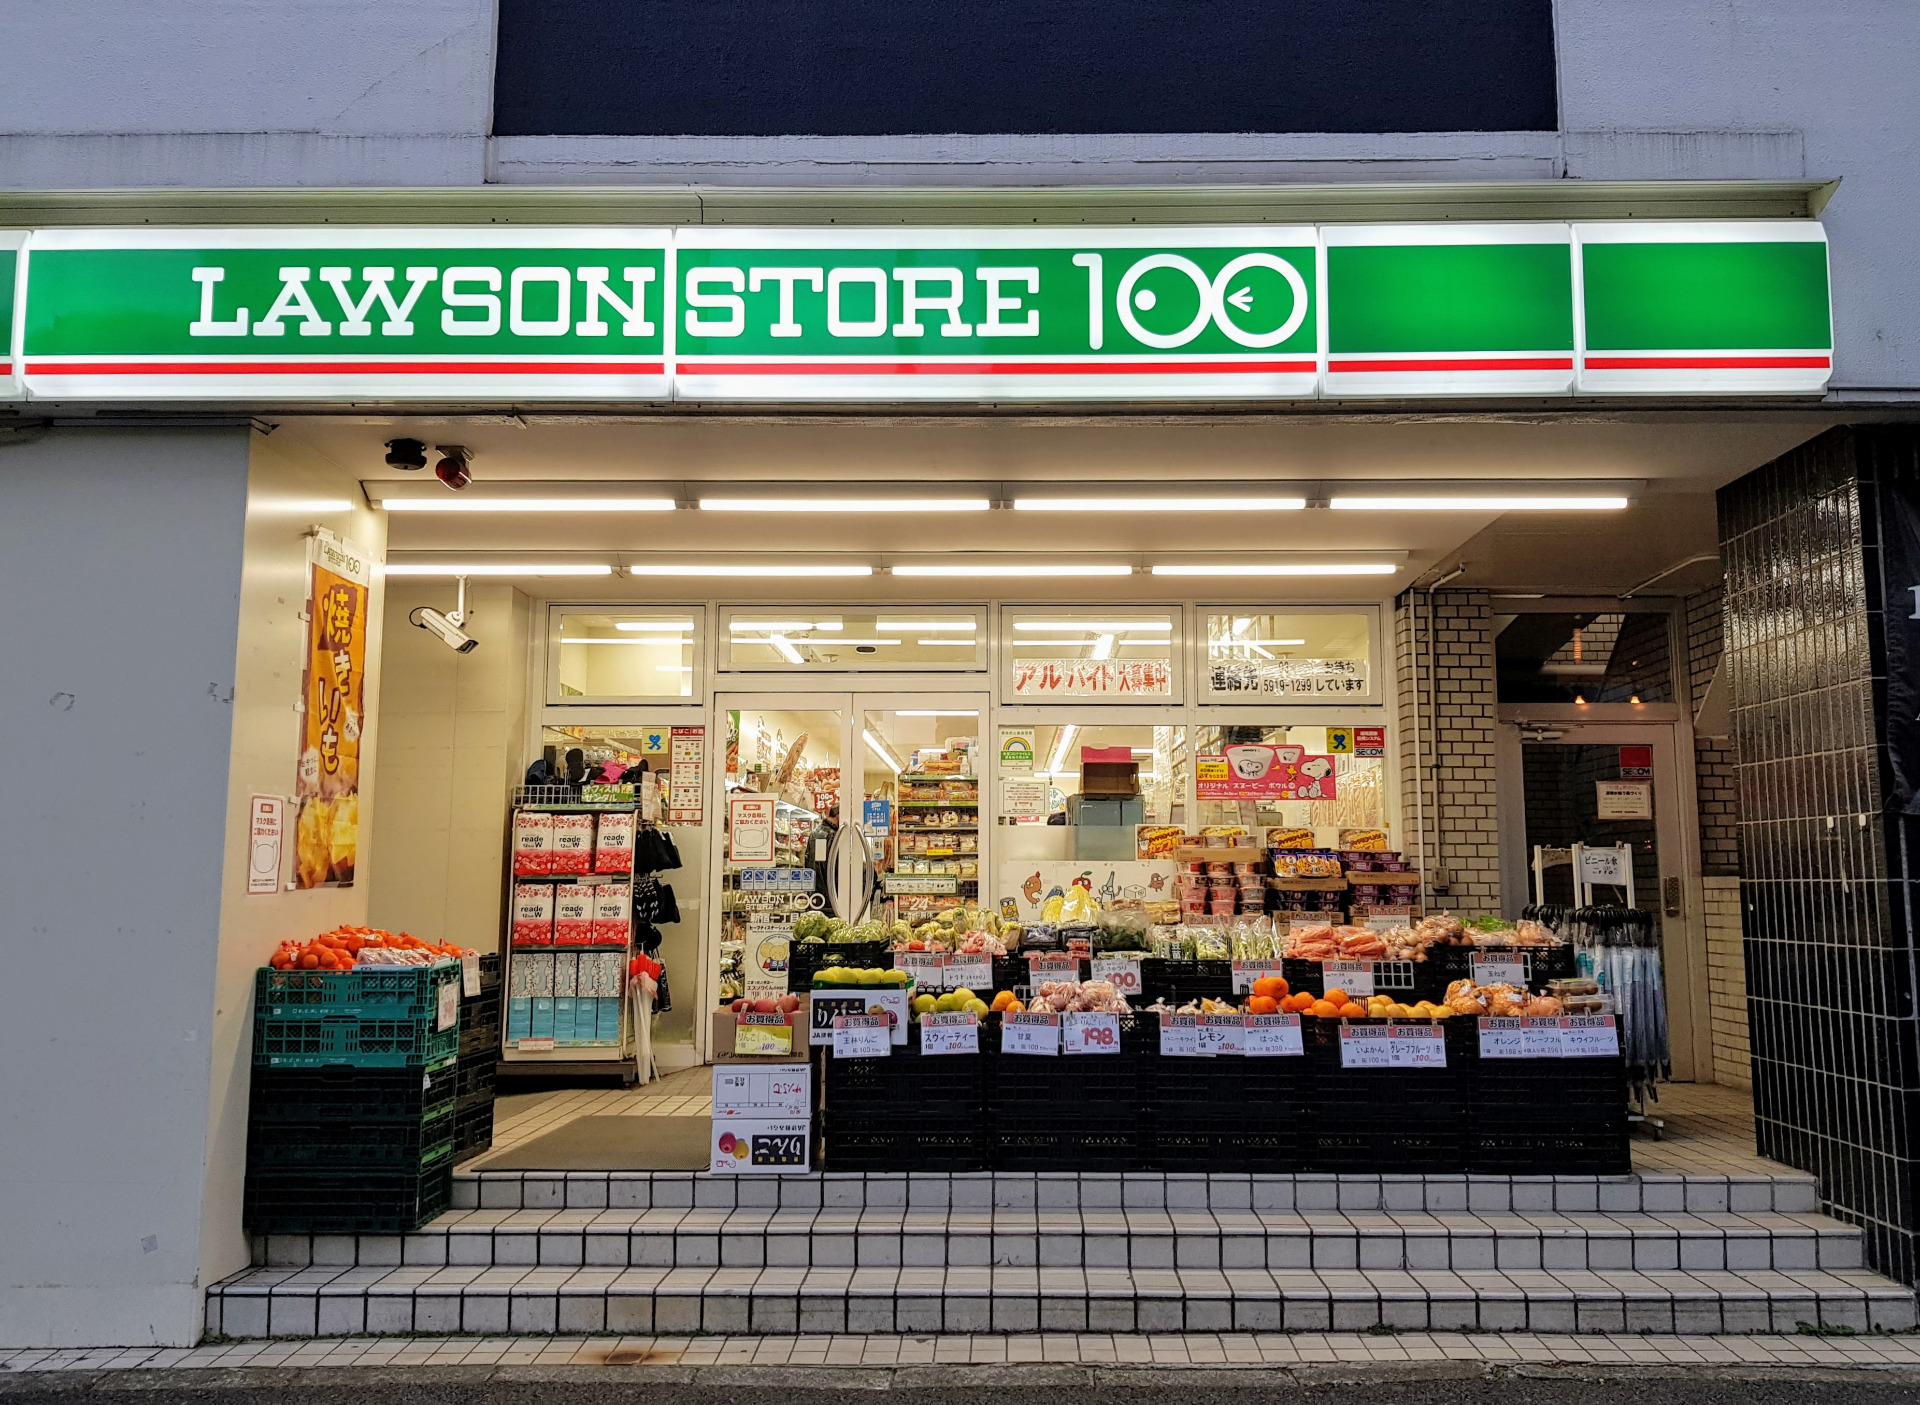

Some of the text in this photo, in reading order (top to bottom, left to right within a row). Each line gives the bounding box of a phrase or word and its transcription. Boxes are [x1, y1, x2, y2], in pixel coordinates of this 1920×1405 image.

[189, 253, 1309, 349] LAWSON STORE 100
[346, 555, 361, 575] 100
[1324, 661, 1355, 674] お待ち
[318, 588, 352, 775] 焼きいも
[1263, 679, 1312, 692] 5919-1299
[1316, 679, 1364, 691] しています
[1356, 748, 1383, 756] SECOM
[1622, 768, 1651, 776] SECOM
[735, 893, 826, 910] LAWSON 100
[909, 896, 929, 911] 24
[746, 1015, 784, 1024] お買得品
[844, 1017, 879, 1027] お買得品
[932, 1014, 967, 1024] お買得品
[1014, 1014, 1049, 1024] お買得品
[1206, 1015, 1241, 1025] お買得品
[1255, 1016, 1290, 1026] お買得品
[1569, 1017, 1605, 1027] お買得品
[925, 1032, 976, 1042] スウィーティー
[1199, 1033, 1225, 1041] レモン
[1351, 1027, 1386, 1037] お買得品
[1397, 1027, 1433, 1037] お買得品
[844, 1035, 878, 1045] 王林りんご
[755, 1136, 801, 1155] りんご
